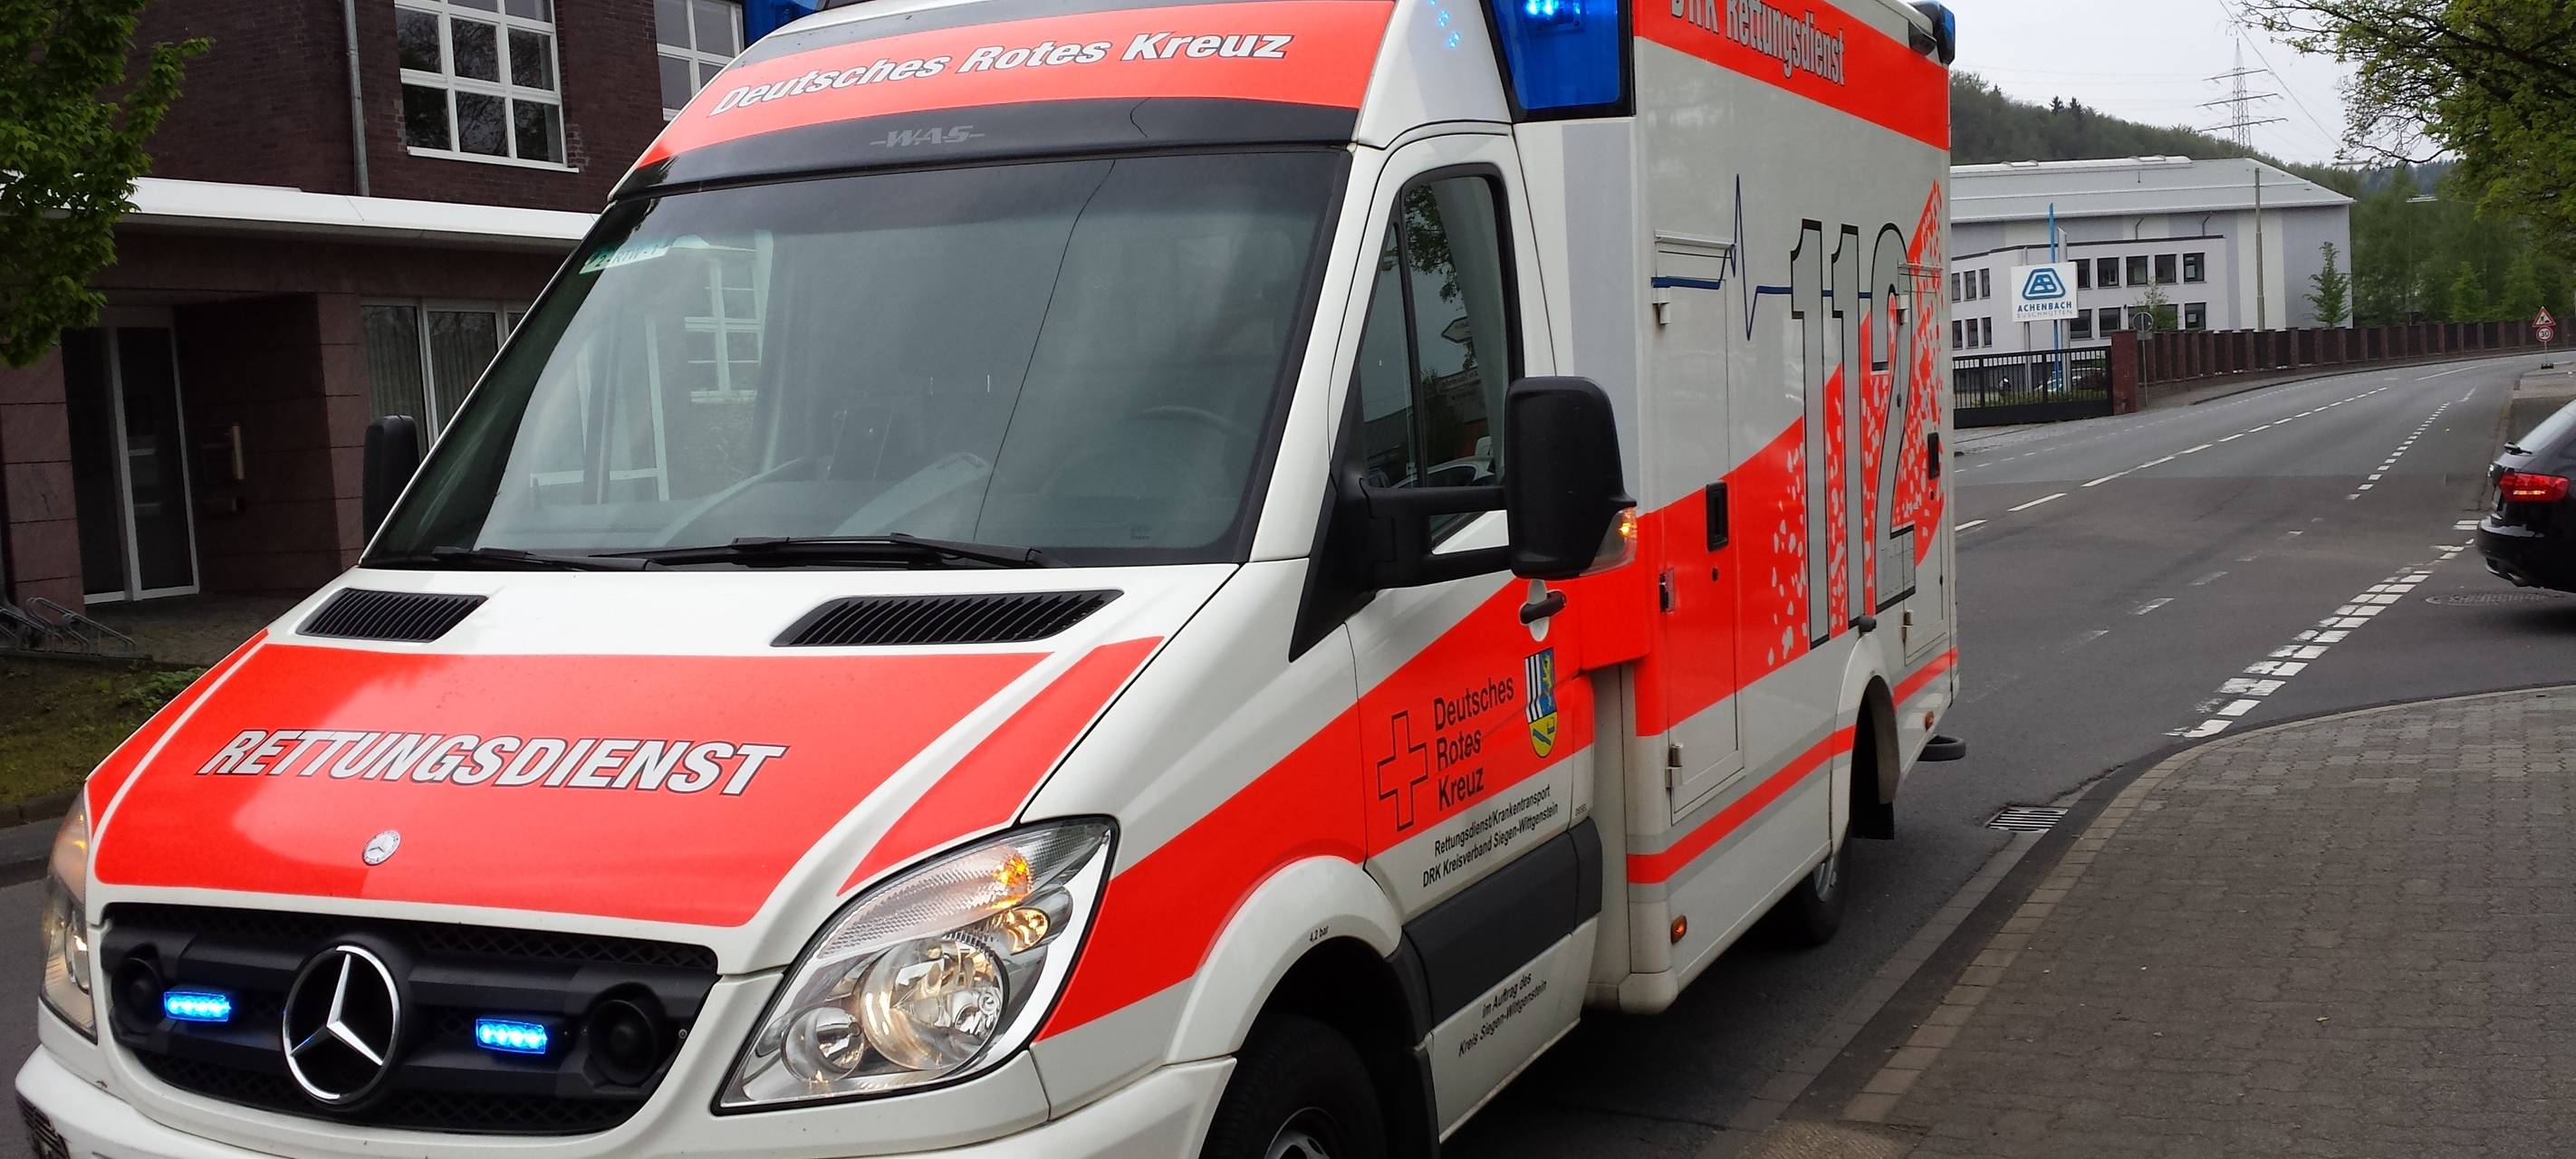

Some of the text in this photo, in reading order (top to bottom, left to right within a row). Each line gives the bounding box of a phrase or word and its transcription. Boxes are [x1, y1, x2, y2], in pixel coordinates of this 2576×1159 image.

[707, 31, 1294, 116] Deutsches Rotes Kreuz
[1726, 0, 1844, 86] Rettungsdienst
[887, 126, 974, 147] WAS
[2018, 302, 2072, 312] ACHENBACH
[1791, 219, 1916, 650] 112
[1434, 677, 1514, 732] Deutsches
[195, 729, 789, 796] RETTUNGSDIENST
[1437, 730, 1482, 771] Rotes
[1435, 783, 1551, 857] Rettungsdienst/Krankentransport
[1438, 768, 1485, 811] Kreuz
[1423, 801, 1558, 887] DRK Kreisverband Siegen-Wittgenstein
[1458, 1033, 1478, 1058] Kreis
